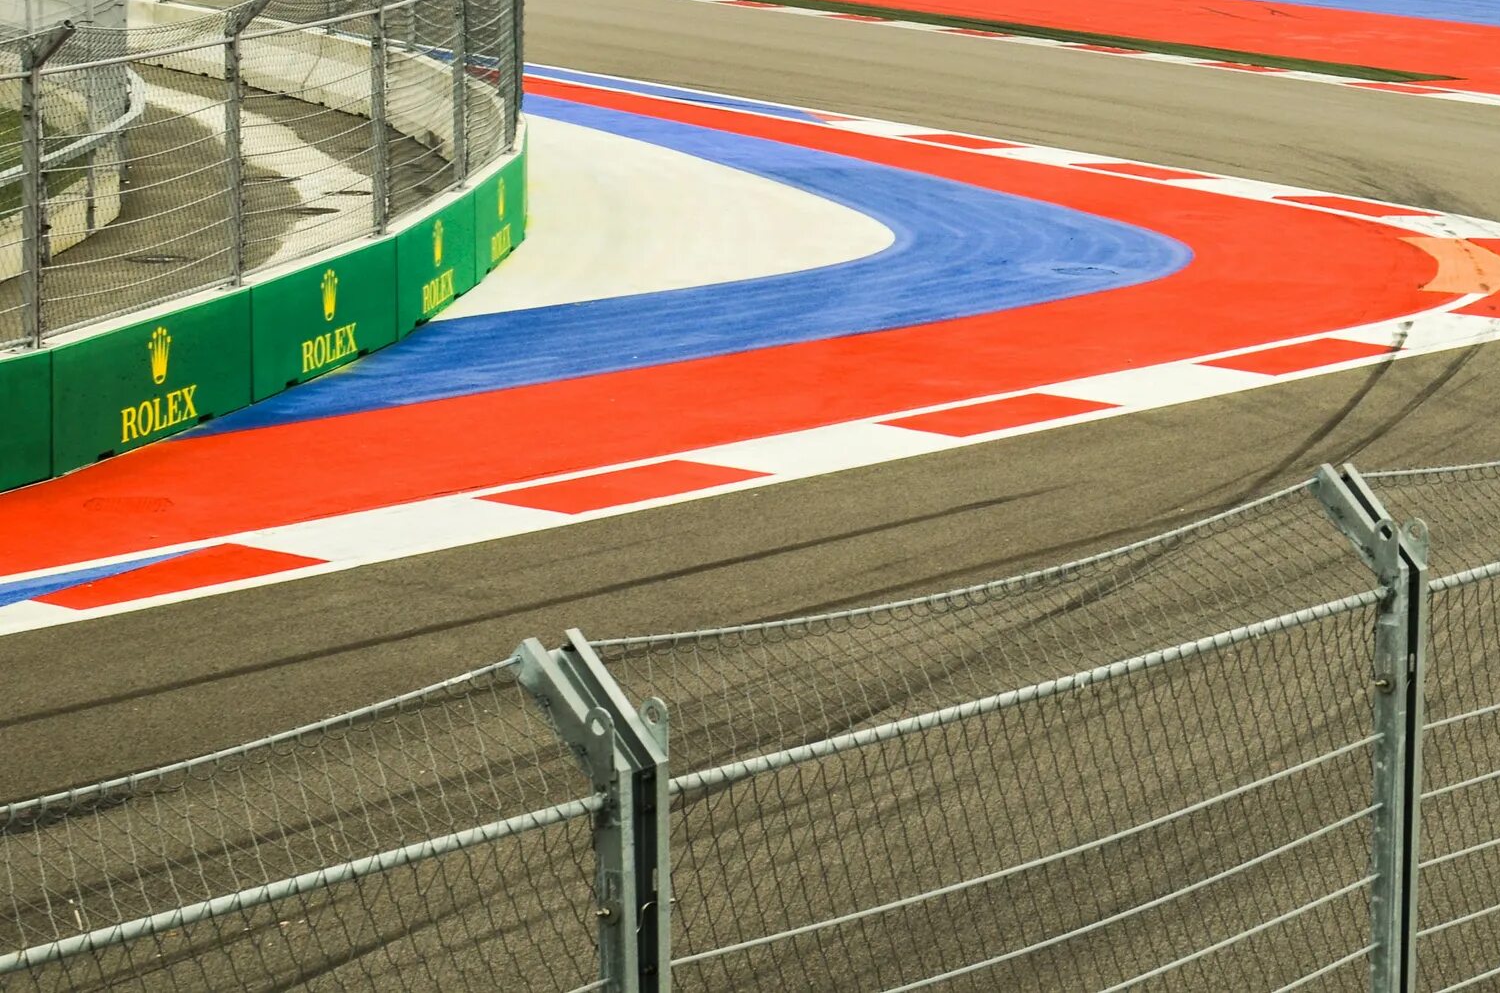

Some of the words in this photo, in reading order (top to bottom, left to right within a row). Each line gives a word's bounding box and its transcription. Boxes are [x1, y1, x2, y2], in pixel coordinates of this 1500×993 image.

[490, 223, 511, 262] ROLEX
[422, 268, 454, 314] ROLEX
[302, 322, 358, 373] ROLEX
[121, 384, 198, 443] ROLEX
